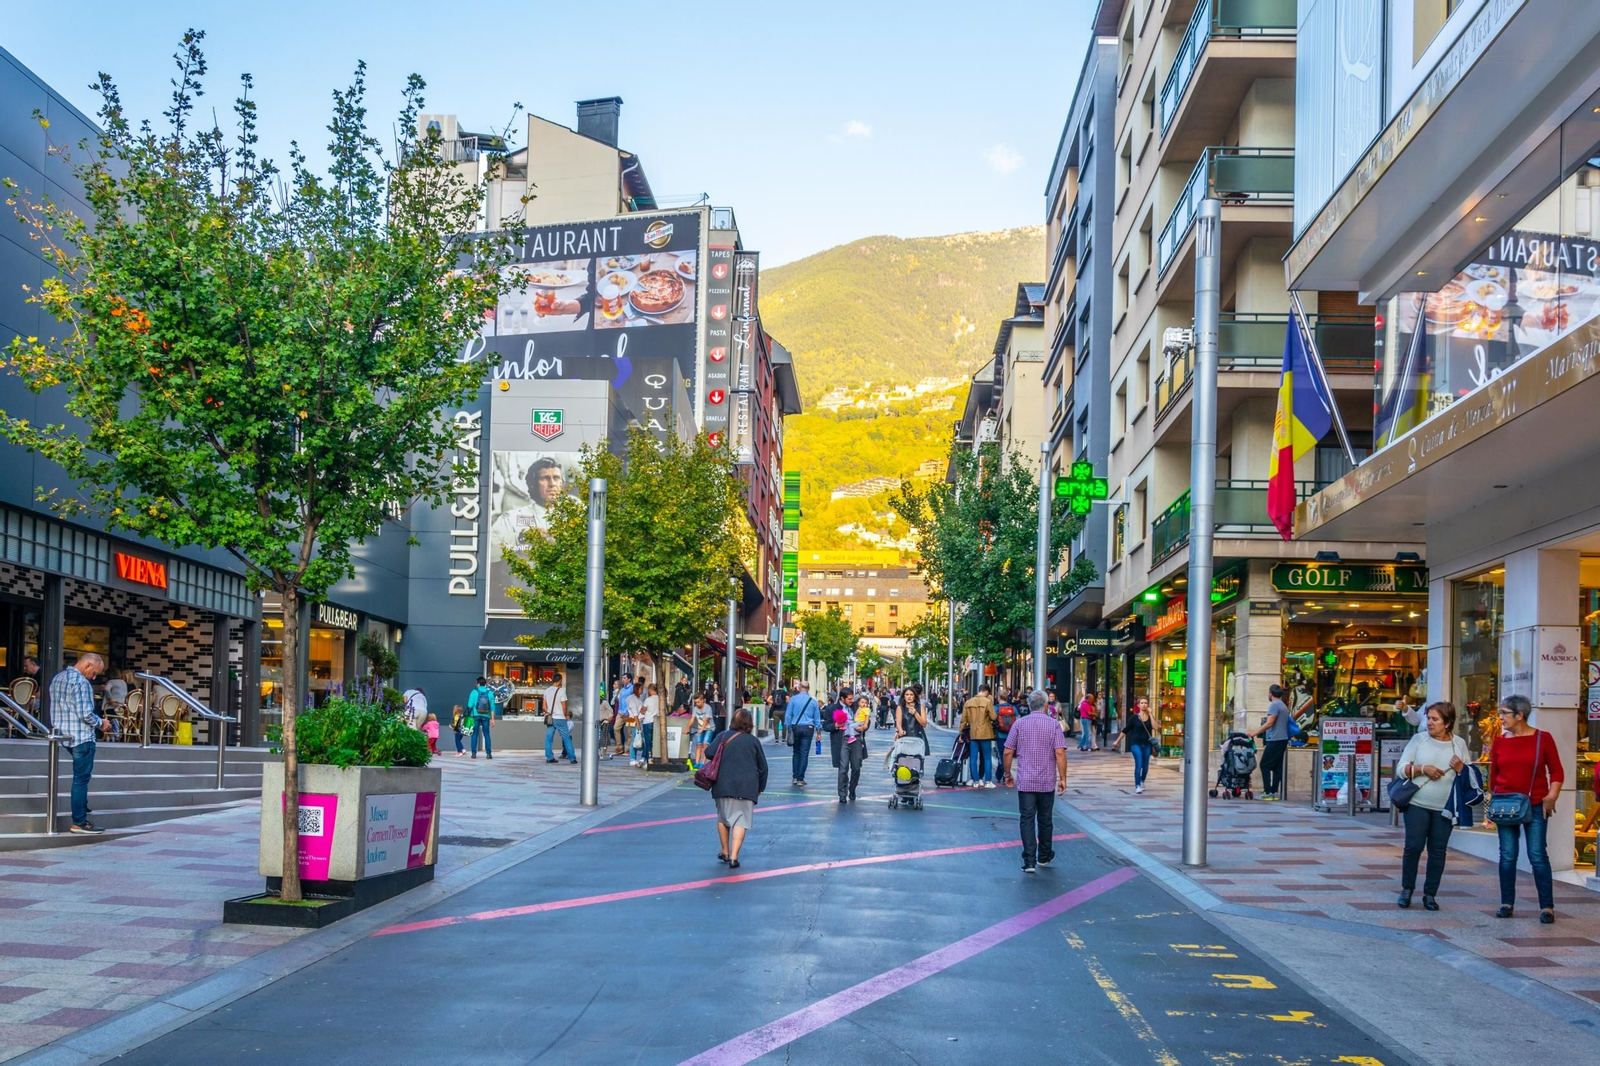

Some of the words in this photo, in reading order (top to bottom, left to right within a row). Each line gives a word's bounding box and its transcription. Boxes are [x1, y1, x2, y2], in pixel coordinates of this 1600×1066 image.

[711, 250, 731, 258] TAPES
[737, 362, 749, 435] RESTAURANT
[538, 412, 557, 423] TAG
[533, 424, 561, 437] HEUER
[114, 552, 168, 589] VIENA
[1288, 568, 1352, 587] GOLF
[319, 604, 358, 631] PULL&BEAR
[485, 650, 518, 661] Cartier
[546, 652, 578, 662] Cartier
[1541, 654, 1578, 662] MAJORICA
